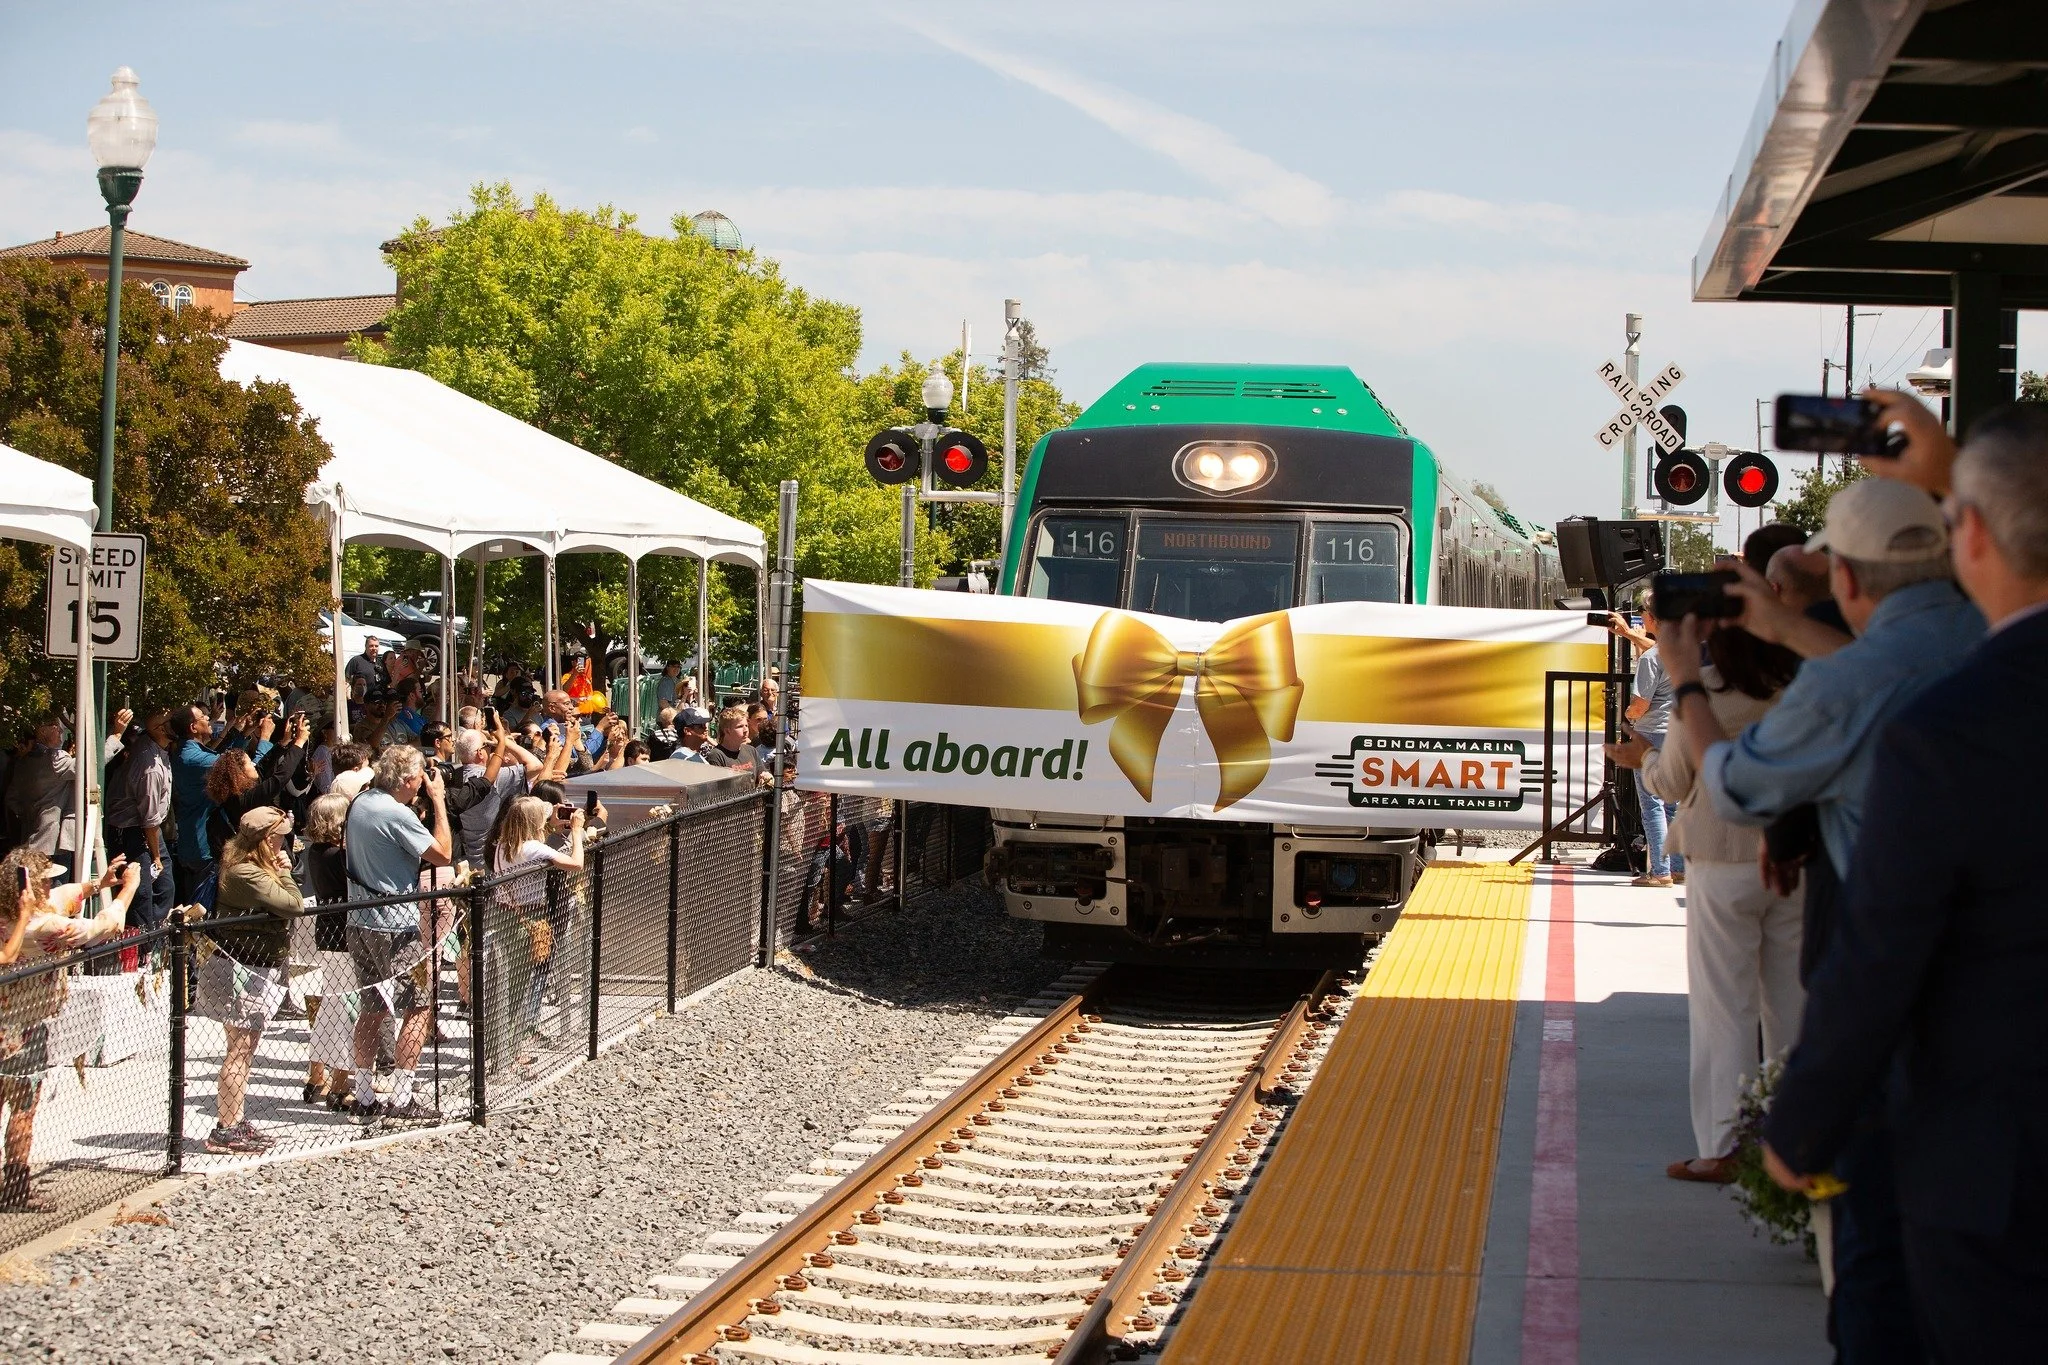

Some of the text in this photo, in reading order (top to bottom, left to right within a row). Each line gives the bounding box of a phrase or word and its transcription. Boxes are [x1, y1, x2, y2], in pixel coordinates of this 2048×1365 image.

[1067, 530, 1115, 555] 116
[1163, 532, 1272, 550] NORTHBOUND
[1326, 538, 1375, 562] 116
[59, 547, 136, 567] SEED
[66, 568, 127, 588] LMIT
[67, 600, 121, 645] 15
[820, 728, 1089, 781] All aboard!
[1361, 757, 1513, 790] SMART
[1361, 796, 1511, 808] AREA RAIL TRANSIT
